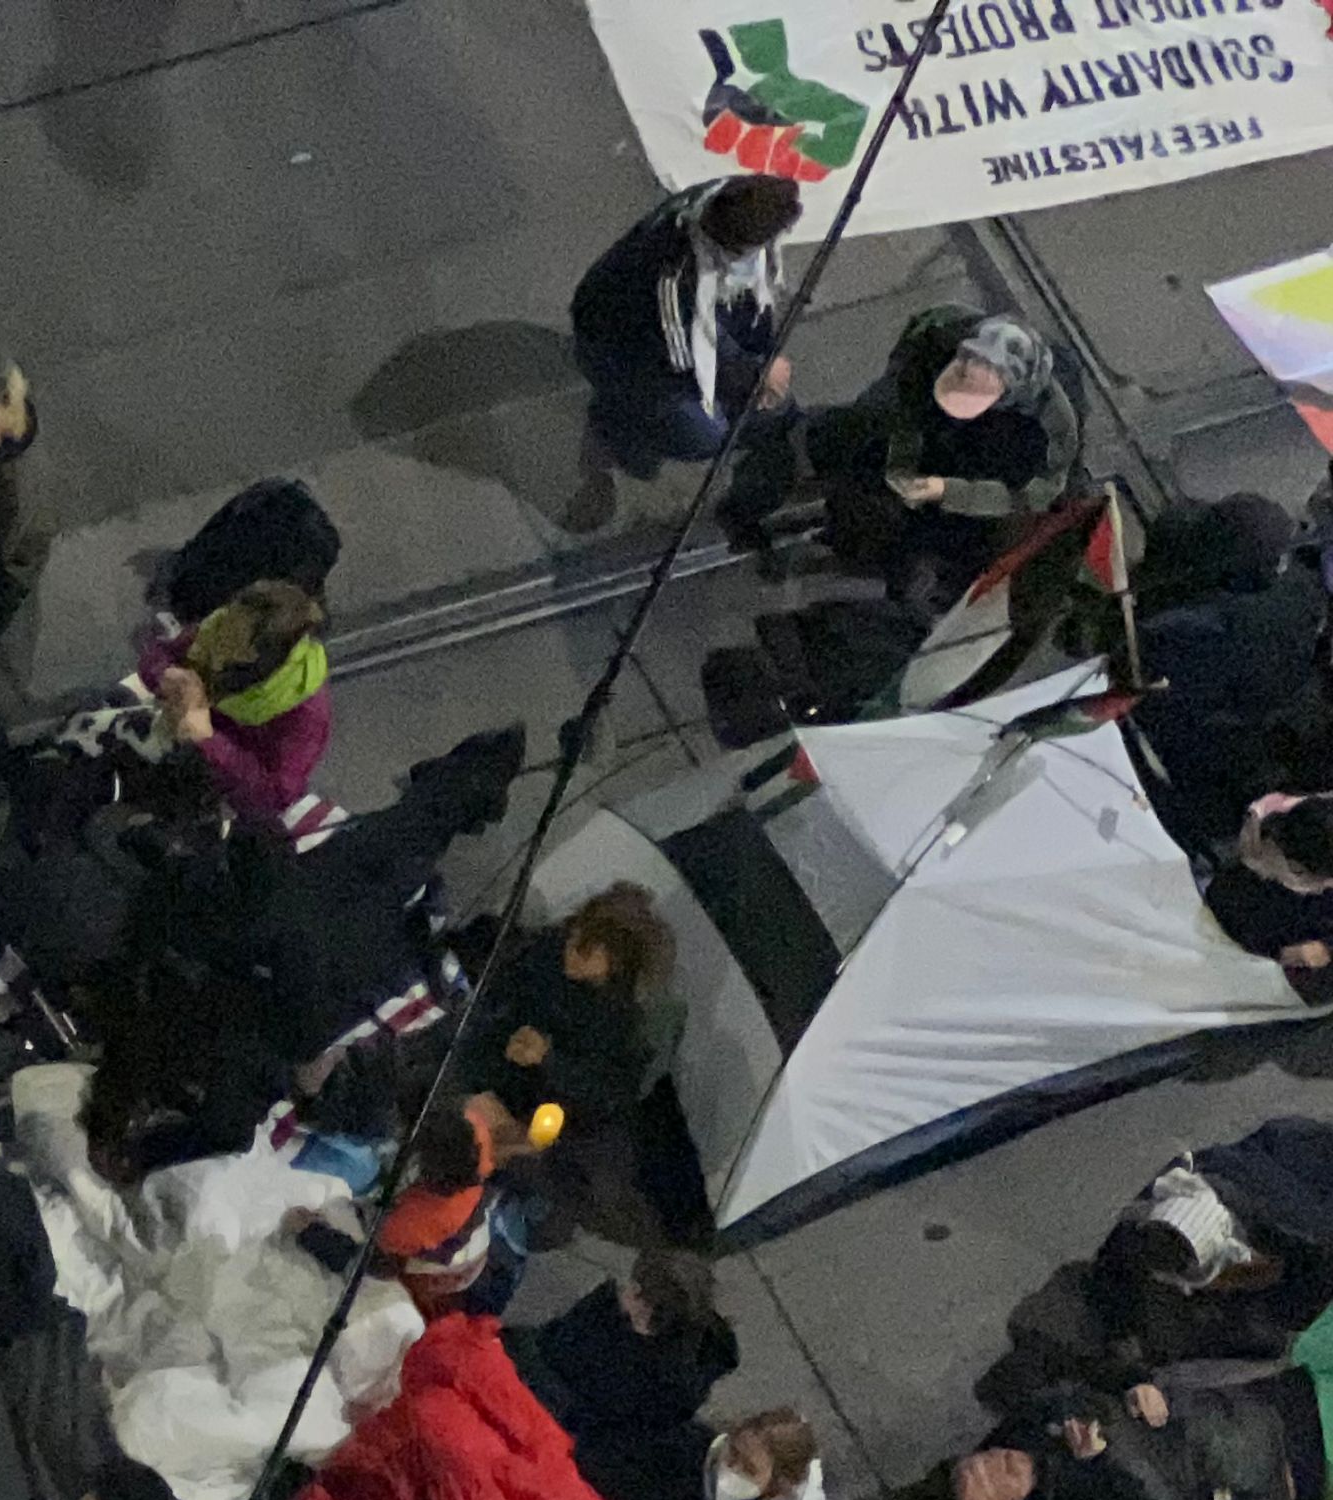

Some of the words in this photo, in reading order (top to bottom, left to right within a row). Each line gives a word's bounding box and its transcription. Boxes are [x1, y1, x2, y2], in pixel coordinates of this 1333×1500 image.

[856, 0, 1077, 72] PROTESTS
[1040, 33, 1295, 113] SOLIDARITY
[895, 77, 1028, 141] WITH
[1170, 115, 1265, 155] FREE
[982, 128, 1171, 186] PALESTINE
